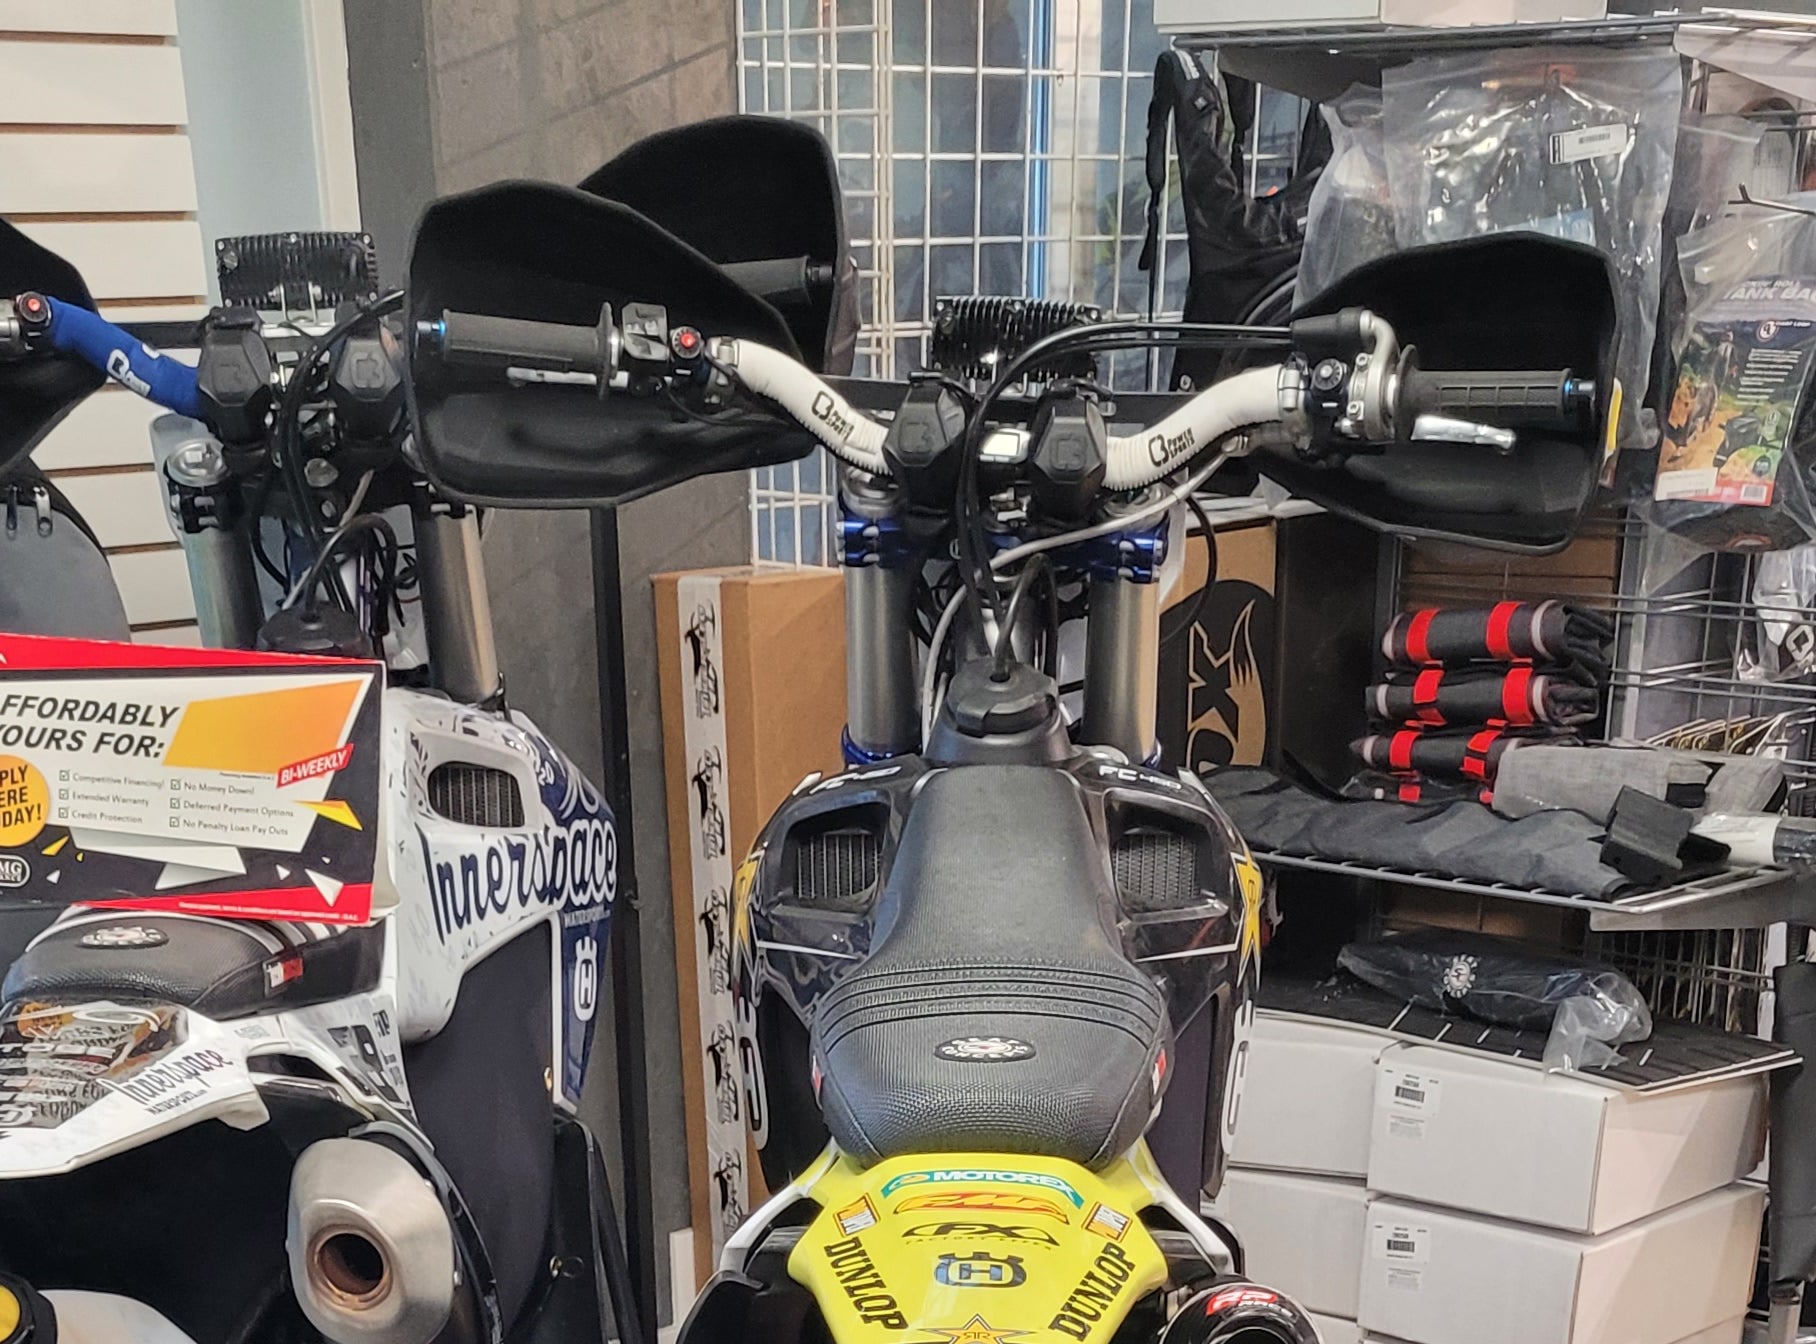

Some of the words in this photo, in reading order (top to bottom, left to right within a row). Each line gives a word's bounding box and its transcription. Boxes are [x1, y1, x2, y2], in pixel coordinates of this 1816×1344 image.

[93, 732, 165, 758] FOR:
[280, 751, 348, 784] BI-WEEKLY
[72, 791, 110, 802] Extended
[112, 794, 149, 808] Warranty
[184, 782, 197, 790] No
[199, 783, 226, 794] Money
[228, 785, 255, 795] Down!
[72, 810, 97, 819] Credit
[99, 812, 143, 823] Protection
[183, 800, 221, 811] Deferred
[223, 804, 259, 814] Payment
[261, 807, 294, 818] Options
[183, 819, 196, 828] No
[198, 821, 228, 832] Penalty
[230, 823, 250, 833] Loan
[252, 825, 267, 835] Pay
[268, 826, 289, 836] Outs
[414, 819, 617, 946] Innerspace
[100, 1049, 233, 1106] Innerspace
[934, 1171, 1077, 1201] MOTOREX
[823, 1236, 909, 1331] DUNLOP
[1048, 1242, 1136, 1342] DUNLOP
